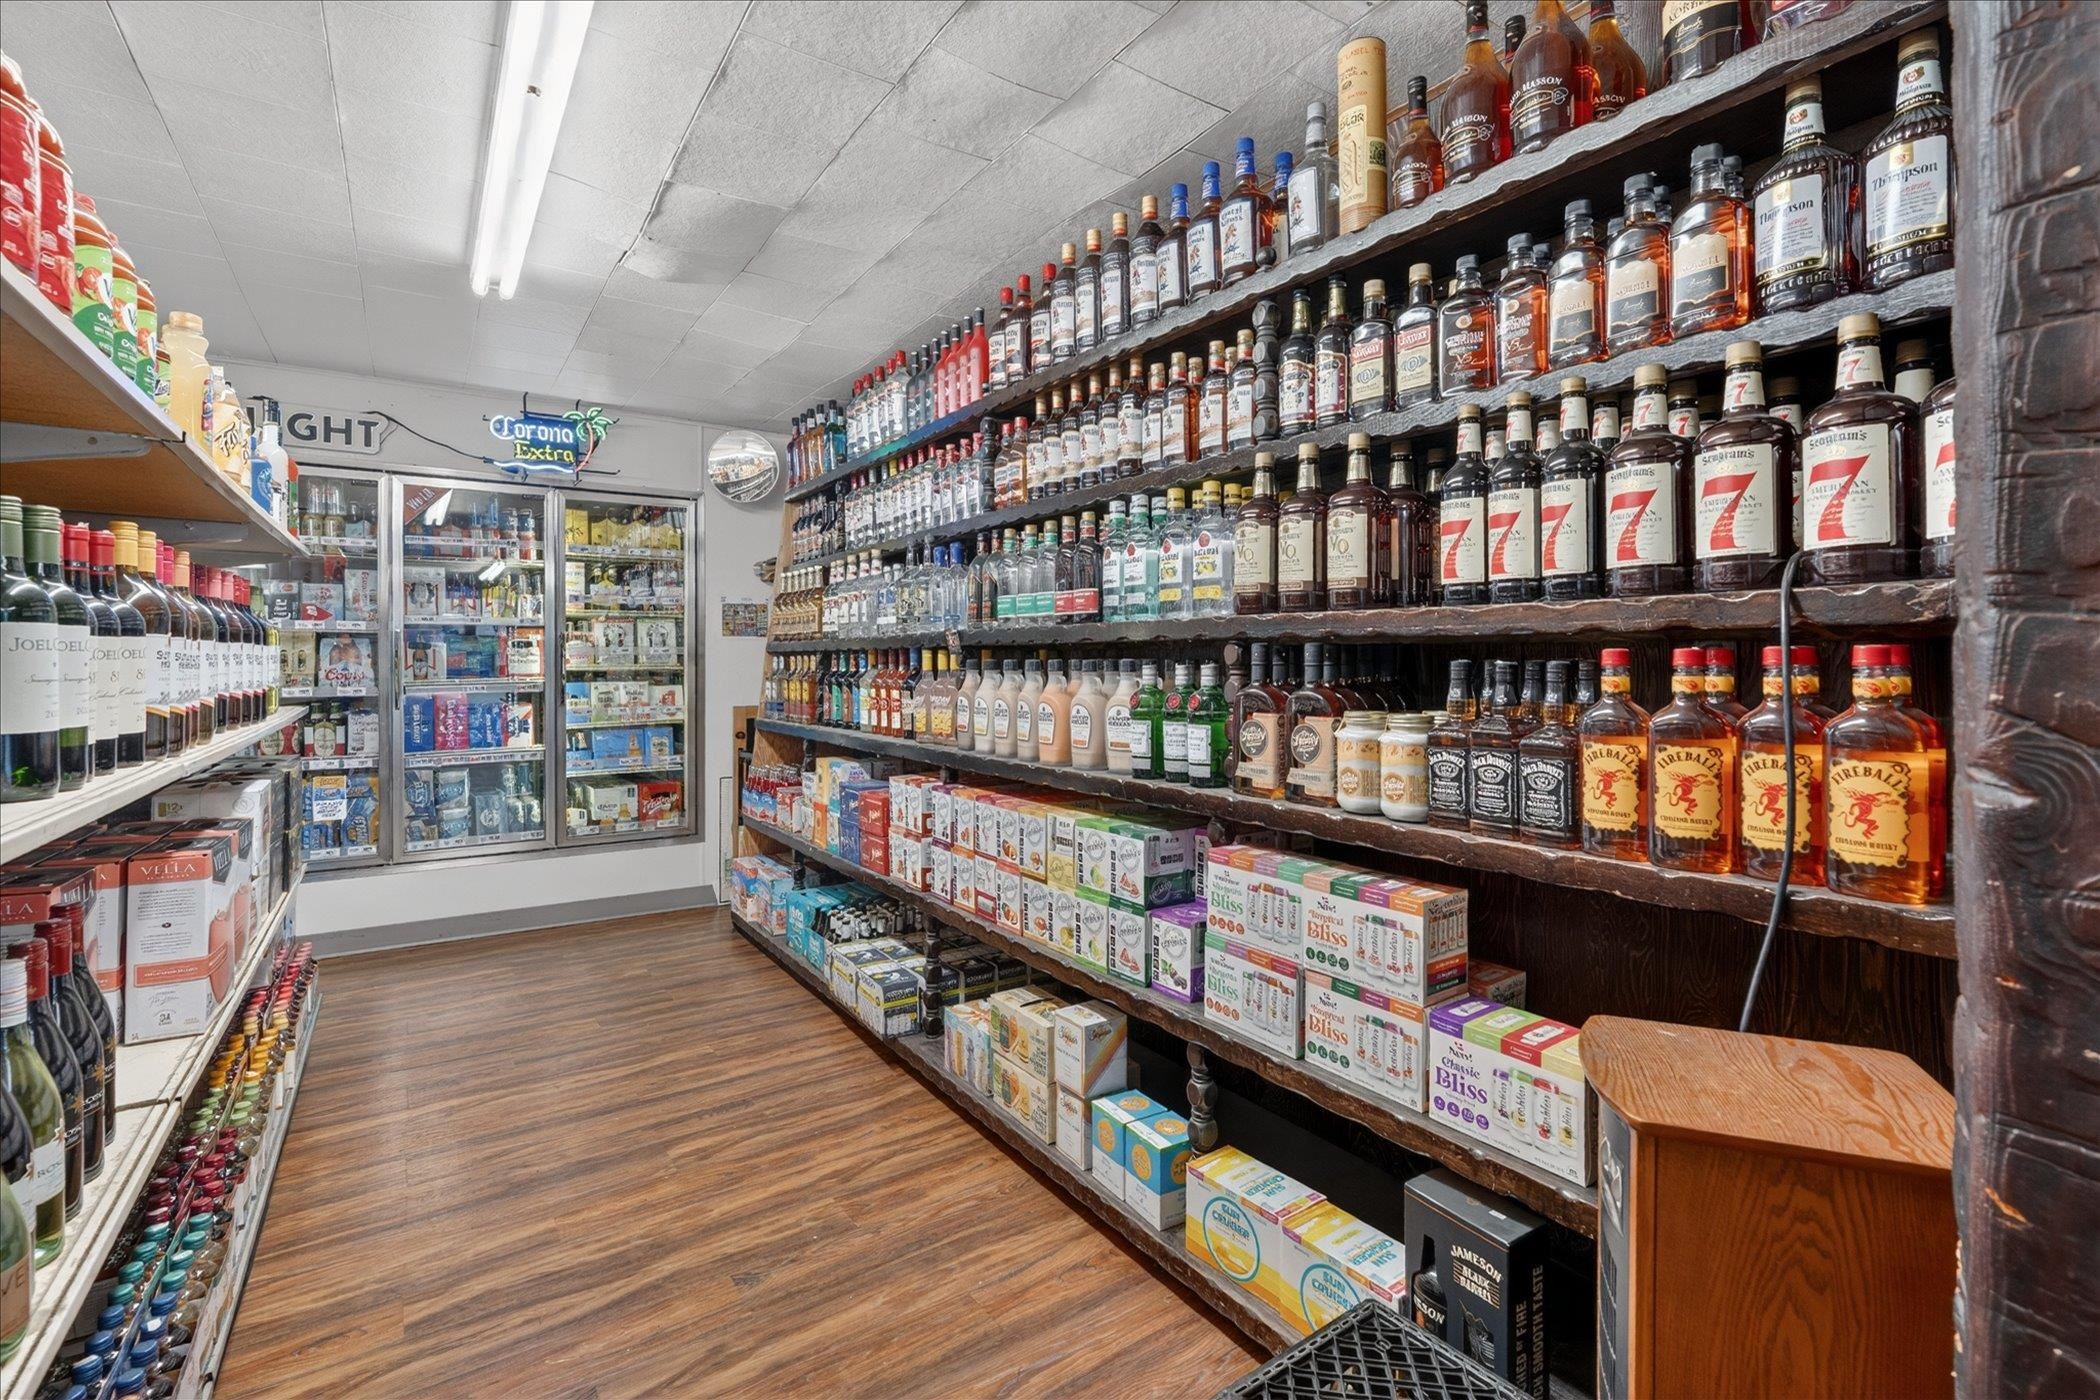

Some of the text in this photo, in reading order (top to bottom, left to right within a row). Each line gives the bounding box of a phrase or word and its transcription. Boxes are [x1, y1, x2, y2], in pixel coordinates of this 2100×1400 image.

[1592, 96, 1627, 105] ASSON
[1842, 358, 1863, 383] 7
[1732, 382, 1748, 405] 7
[266, 408, 379, 448] GHT
[1637, 402, 1653, 426] 7
[1674, 416, 1691, 436] 7
[489, 414, 574, 444] Corona
[1808, 429, 1869, 451] Seagram's
[513, 439, 576, 464] Extra
[1701, 470, 1758, 552] 7
[1808, 453, 1872, 542] 7
[1541, 501, 1575, 571] 7
[1609, 487, 1659, 562] 7
[1441, 518, 1474, 580] 7
[1488, 510, 1523, 576] 7
[8, 636, 54, 653] JOEL
[1585, 746, 1640, 774] FIREBALL
[1657, 751, 1721, 776] FIREBALL
[1831, 765, 1909, 792] FIREBALL
[141, 861, 196, 876] VELLA
[1210, 890, 1244, 916] Bliss
[1306, 920, 1349, 949] Bliss
[1308, 1013, 1349, 1046] Bliss
[1441, 1055, 1481, 1081] Classic
[1434, 1065, 1489, 1105] Bliss
[1450, 1244, 1503, 1284] JAMESON
[1532, 1263, 1544, 1311] TASTE
[1516, 1300, 1527, 1337] FIRE
[1532, 1312, 1544, 1374] SMOOTH
